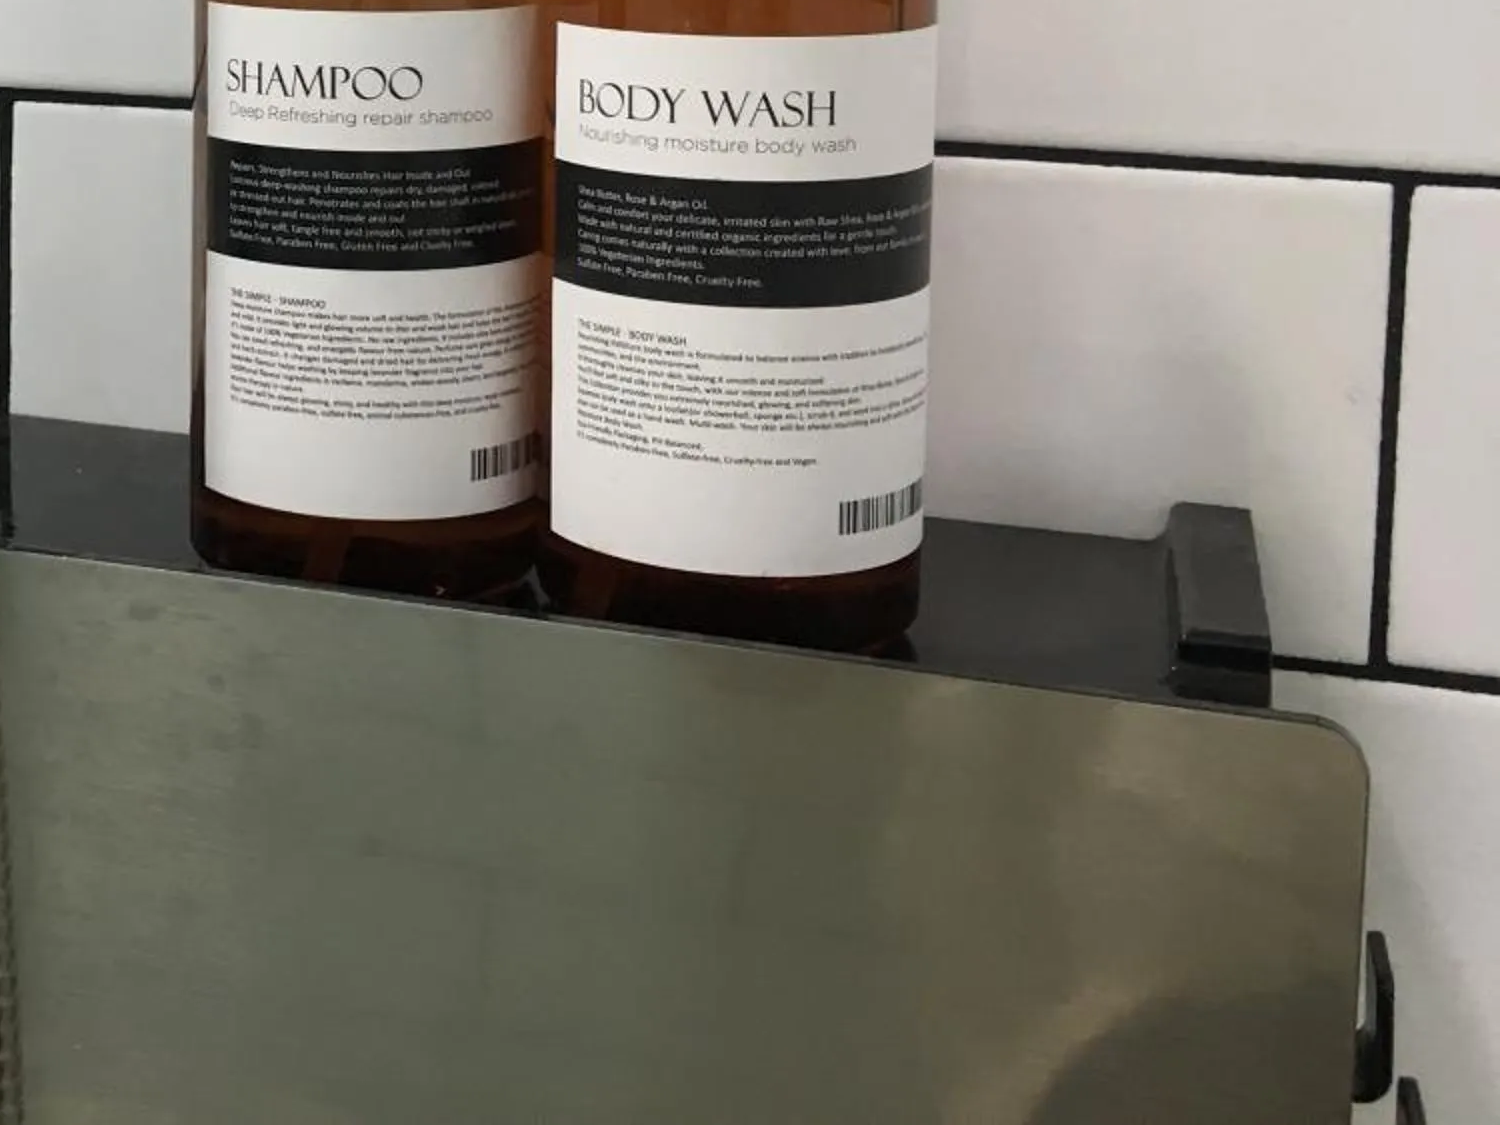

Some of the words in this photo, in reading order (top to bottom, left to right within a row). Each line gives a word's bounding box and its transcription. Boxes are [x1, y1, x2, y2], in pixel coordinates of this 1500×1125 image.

[227, 58, 423, 101] SHAMPOO
[229, 101, 265, 121] Deep
[267, 105, 357, 128] Refreshing
[362, 111, 413, 126] repair
[418, 108, 493, 126] shampoo
[579, 78, 686, 124] BODY
[701, 90, 836, 128] WASH
[579, 123, 659, 151] Nourishing
[663, 137, 749, 154] moisture
[754, 138, 805, 157] body
[810, 137, 857, 153] wash
[659, 196, 690, 210] Argan
[770, 216, 791, 227] skin
[657, 333, 687, 346] WASH
